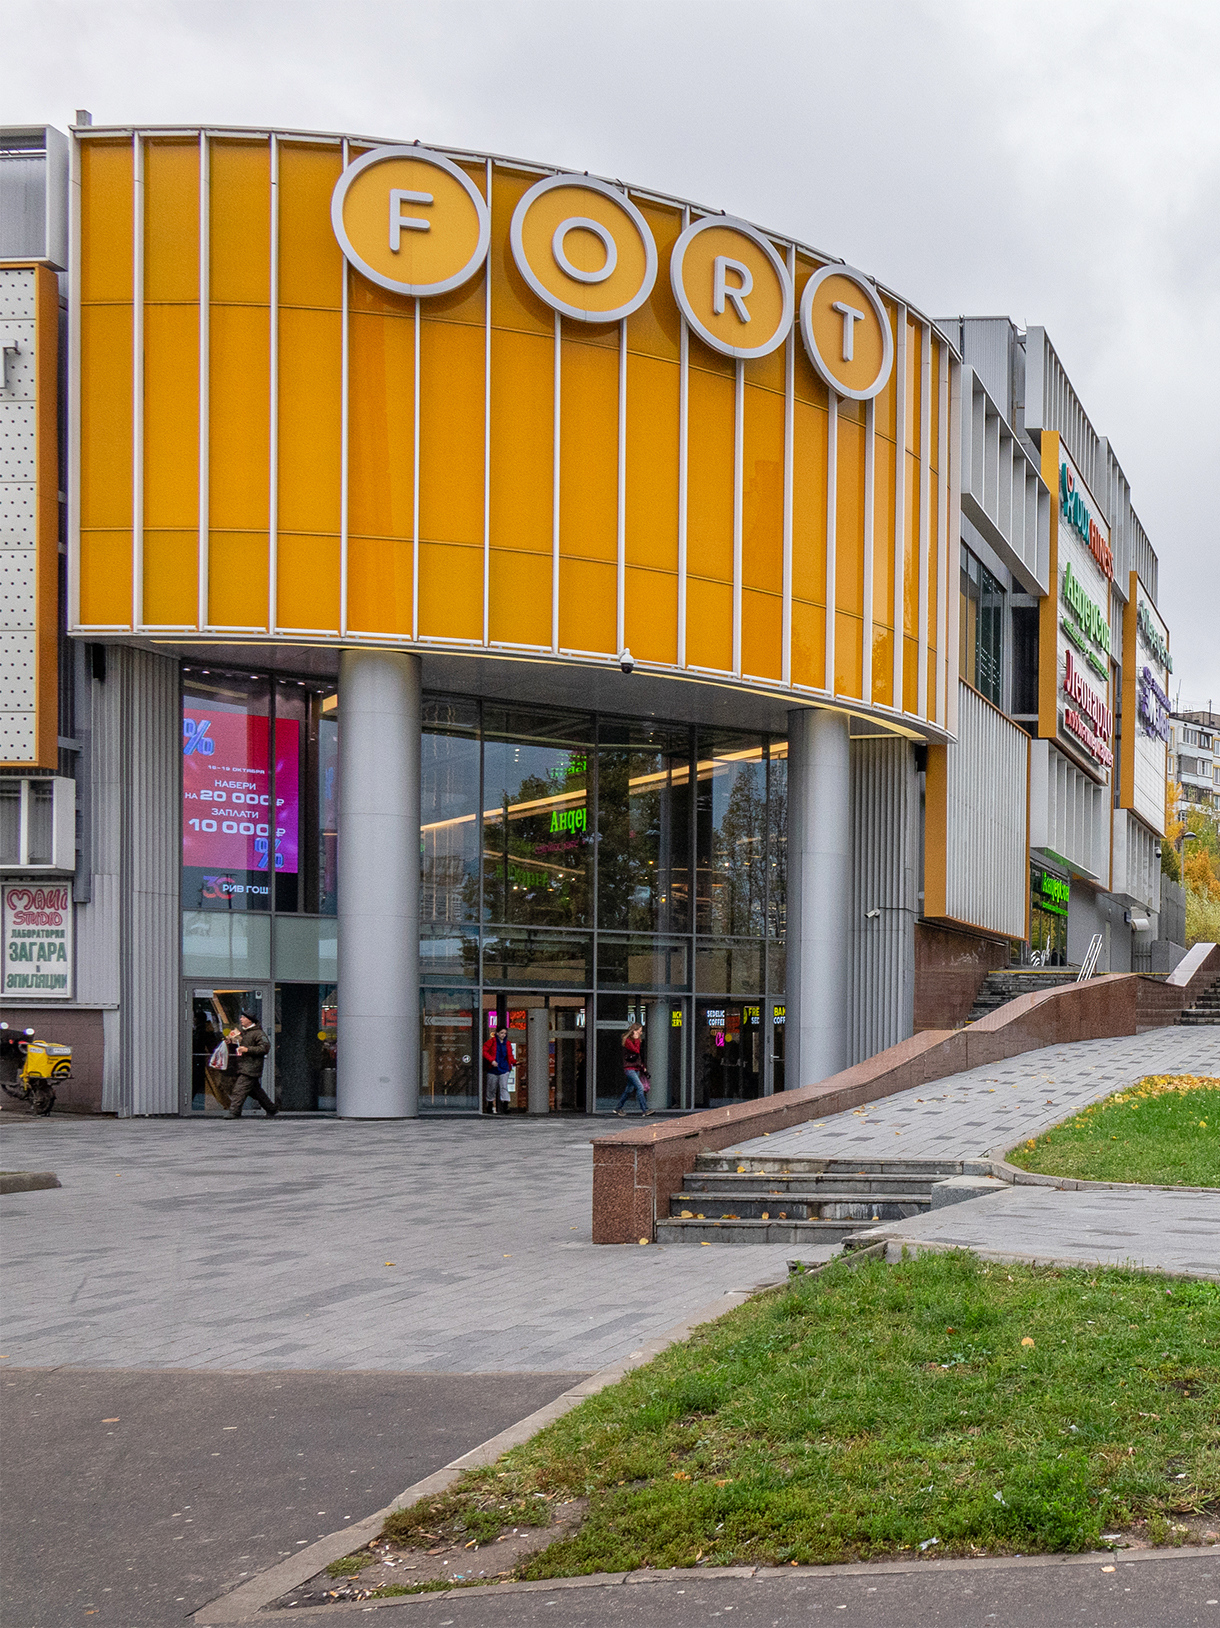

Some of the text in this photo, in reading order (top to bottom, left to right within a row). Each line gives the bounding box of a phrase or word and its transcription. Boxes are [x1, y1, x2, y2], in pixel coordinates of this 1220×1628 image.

[389, 187, 866, 362] FORT
[1064, 649, 1113, 742] Леонардо
[214, 779, 256, 790] НАБЕРИ
[200, 789, 227, 802] 20
[232, 792, 269, 806] 000
[211, 807, 259, 819] ЗАПЛАТИ
[189, 818, 218, 832] 10
[222, 820, 269, 836] 000
[222, 884, 244, 893] РИВ
[246, 885, 269, 894] ГОШ
[13, 911, 63, 927] STUDIO
[11, 929, 65, 938] ЛАБОРАТОРИЯ
[9, 942, 68, 962] ЗАГАРА
[7, 973, 68, 990] ЭПИЛЯЦИИ
